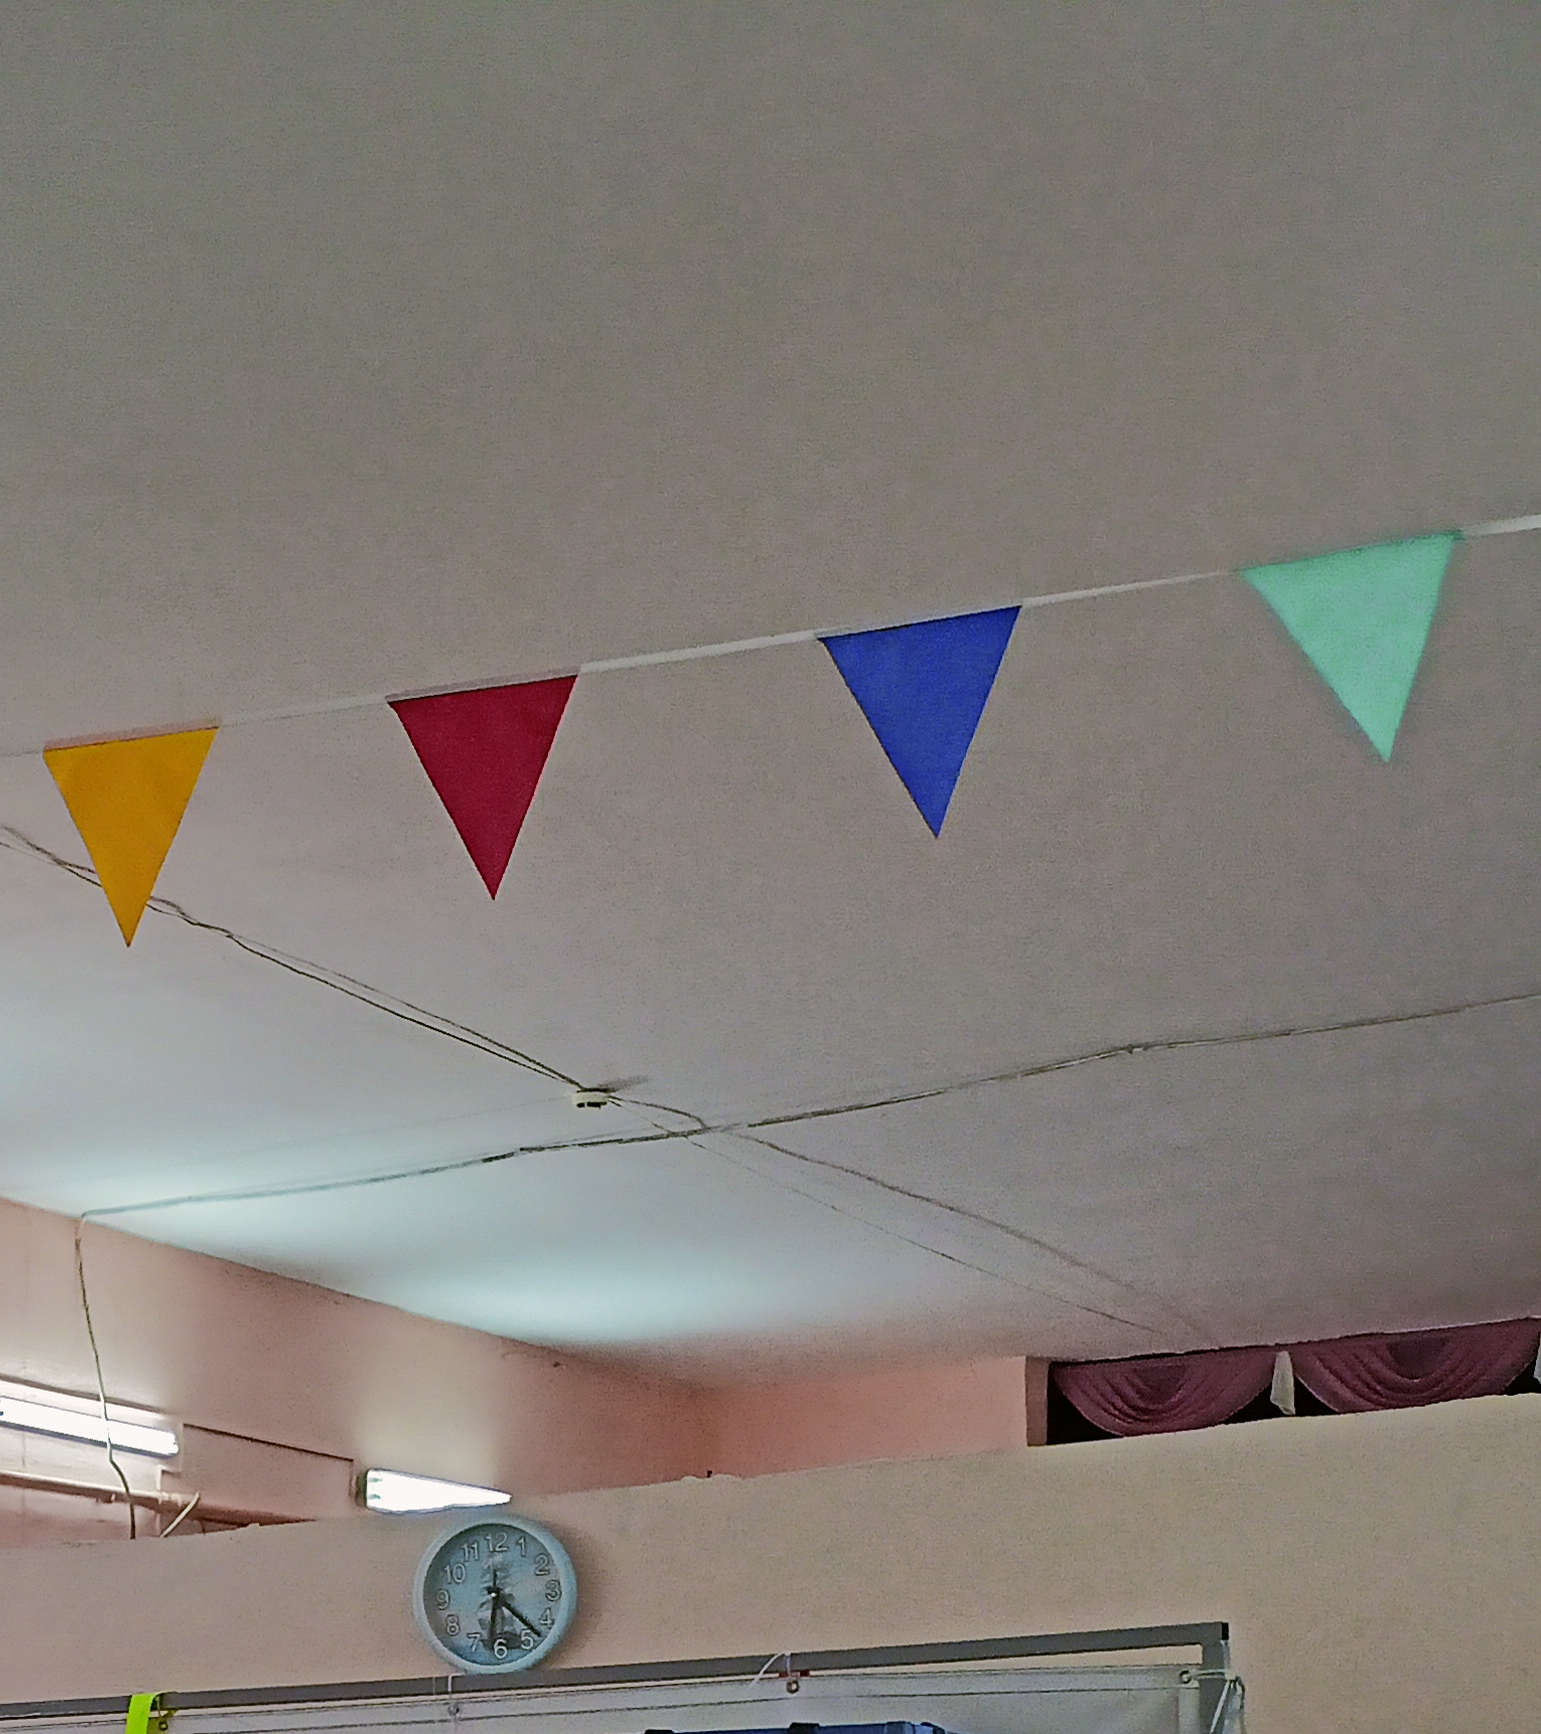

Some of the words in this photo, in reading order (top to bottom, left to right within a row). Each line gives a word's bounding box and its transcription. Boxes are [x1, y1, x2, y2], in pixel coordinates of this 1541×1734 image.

[462, 1542, 480, 1562] 11
[484, 1532, 510, 1552] 12
[517, 1536, 527, 1557] 1
[444, 1563, 466, 1585] 10
[534, 1554, 550, 1576] 2
[436, 1589, 450, 1611] 9
[545, 1579, 562, 1601] 3
[446, 1614, 461, 1636] 8
[539, 1607, 555, 1629] 4
[467, 1632, 481, 1653] 7
[493, 1638, 507, 1660] 6
[520, 1628, 534, 1650] 5
